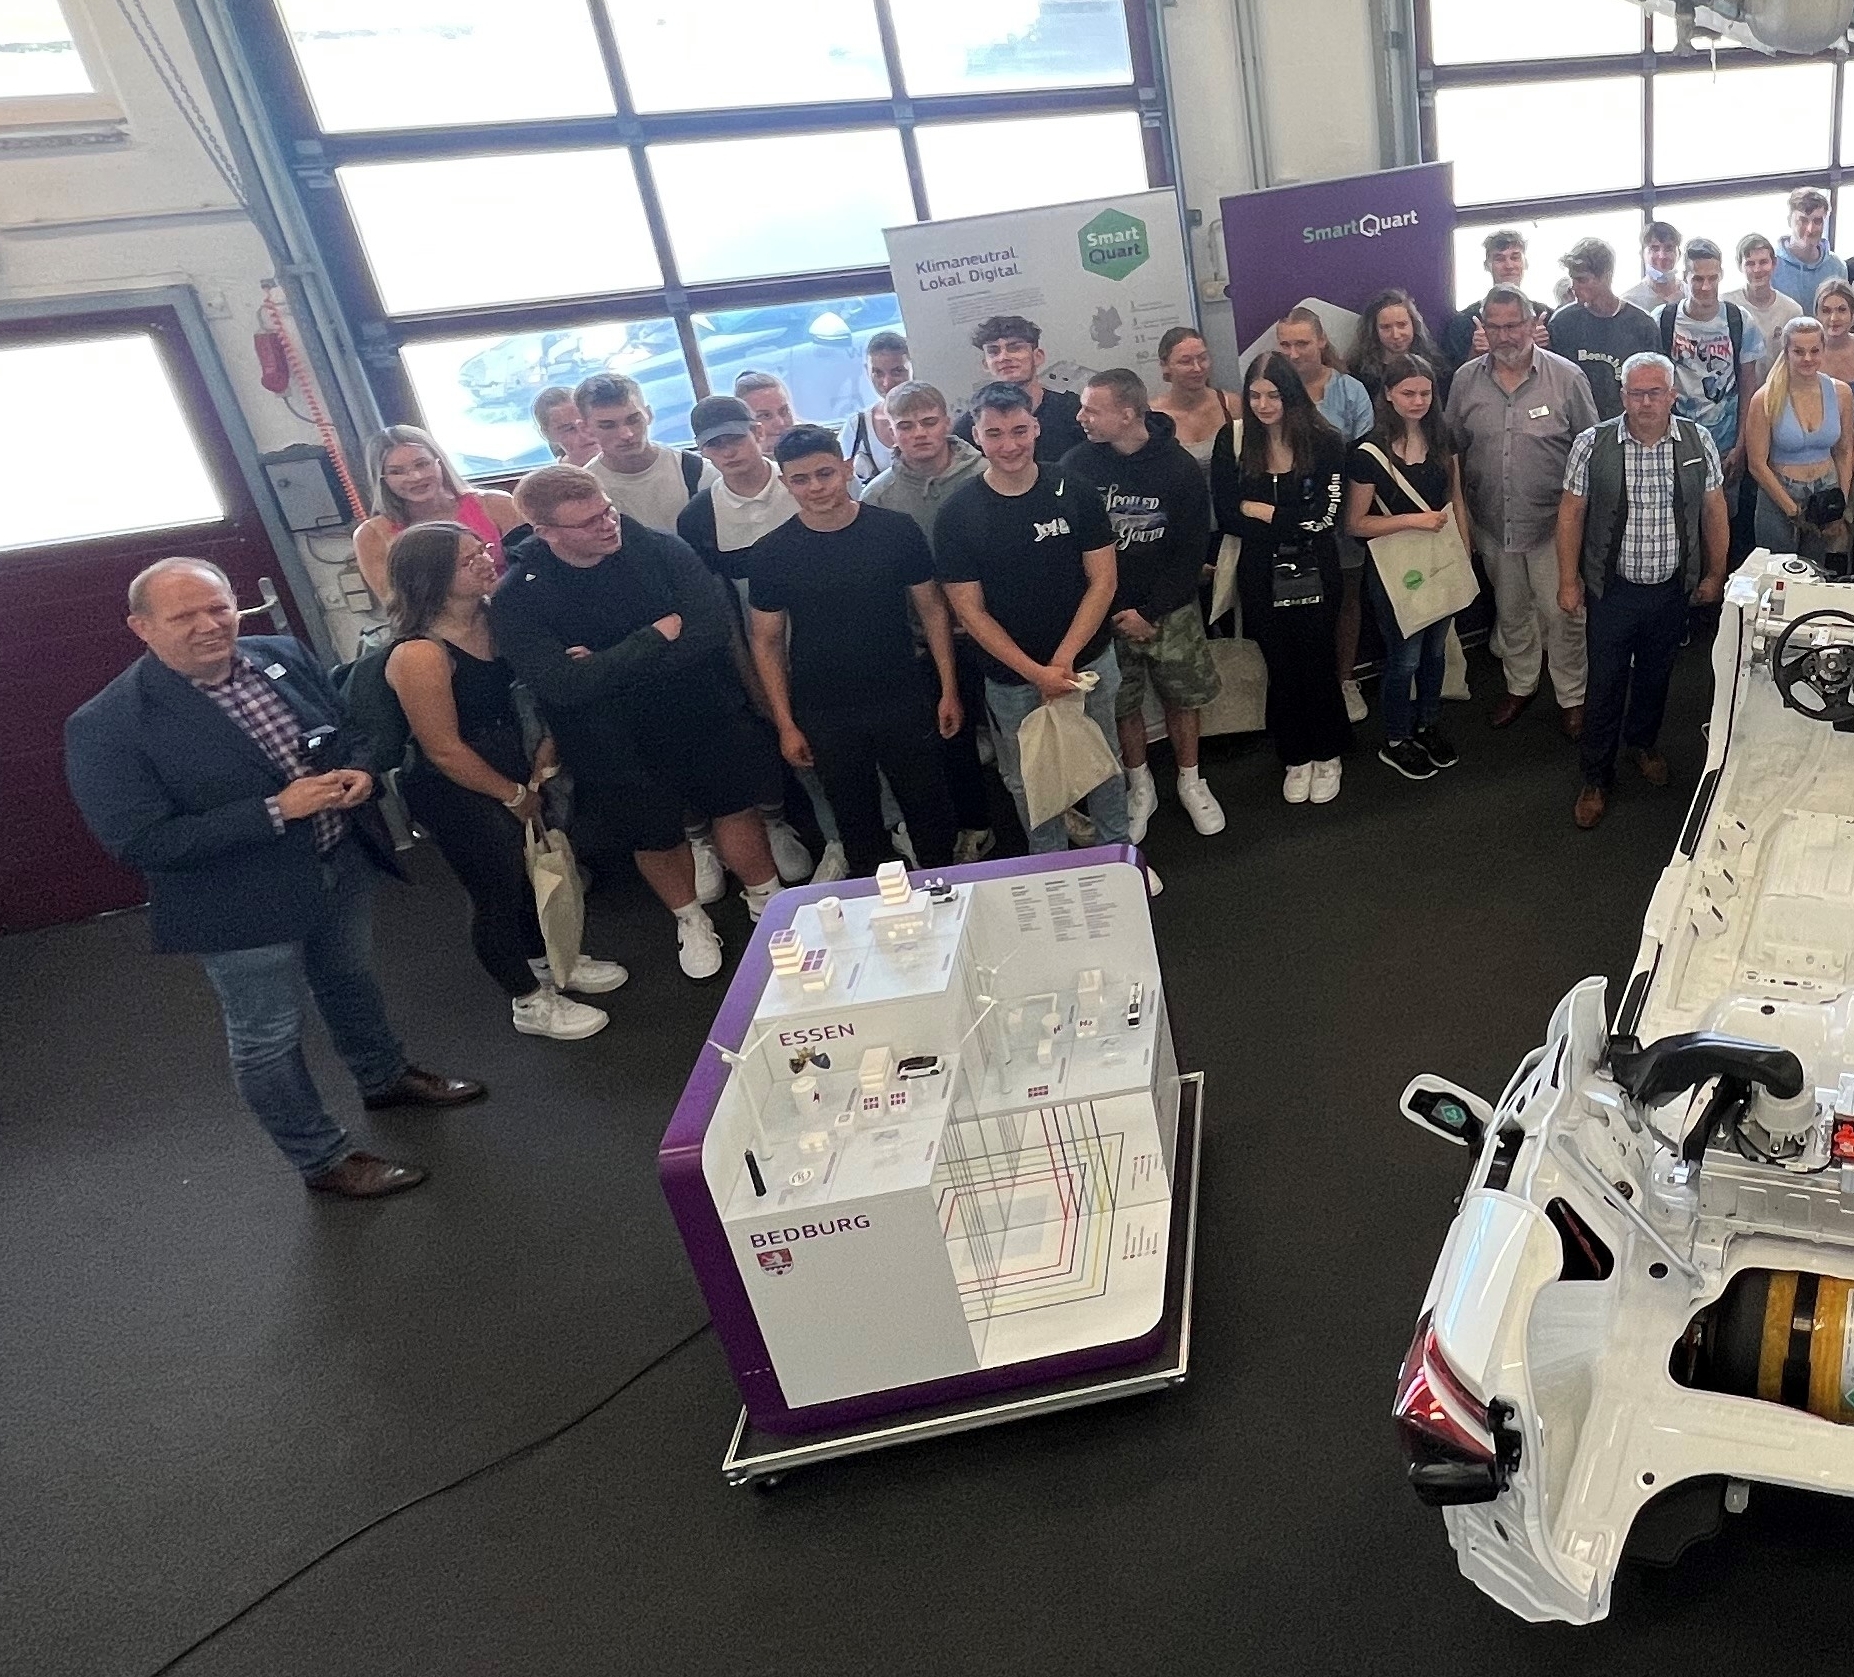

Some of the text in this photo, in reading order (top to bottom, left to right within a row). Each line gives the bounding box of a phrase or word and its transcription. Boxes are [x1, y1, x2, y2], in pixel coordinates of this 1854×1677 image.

[1086, 226, 1140, 247] Smart
[1302, 210, 1419, 244] SmartQuart
[1088, 243, 1143, 265] Quart
[779, 1022, 856, 1047] ESSEN
[749, 1213, 871, 1249] BEDBURG
